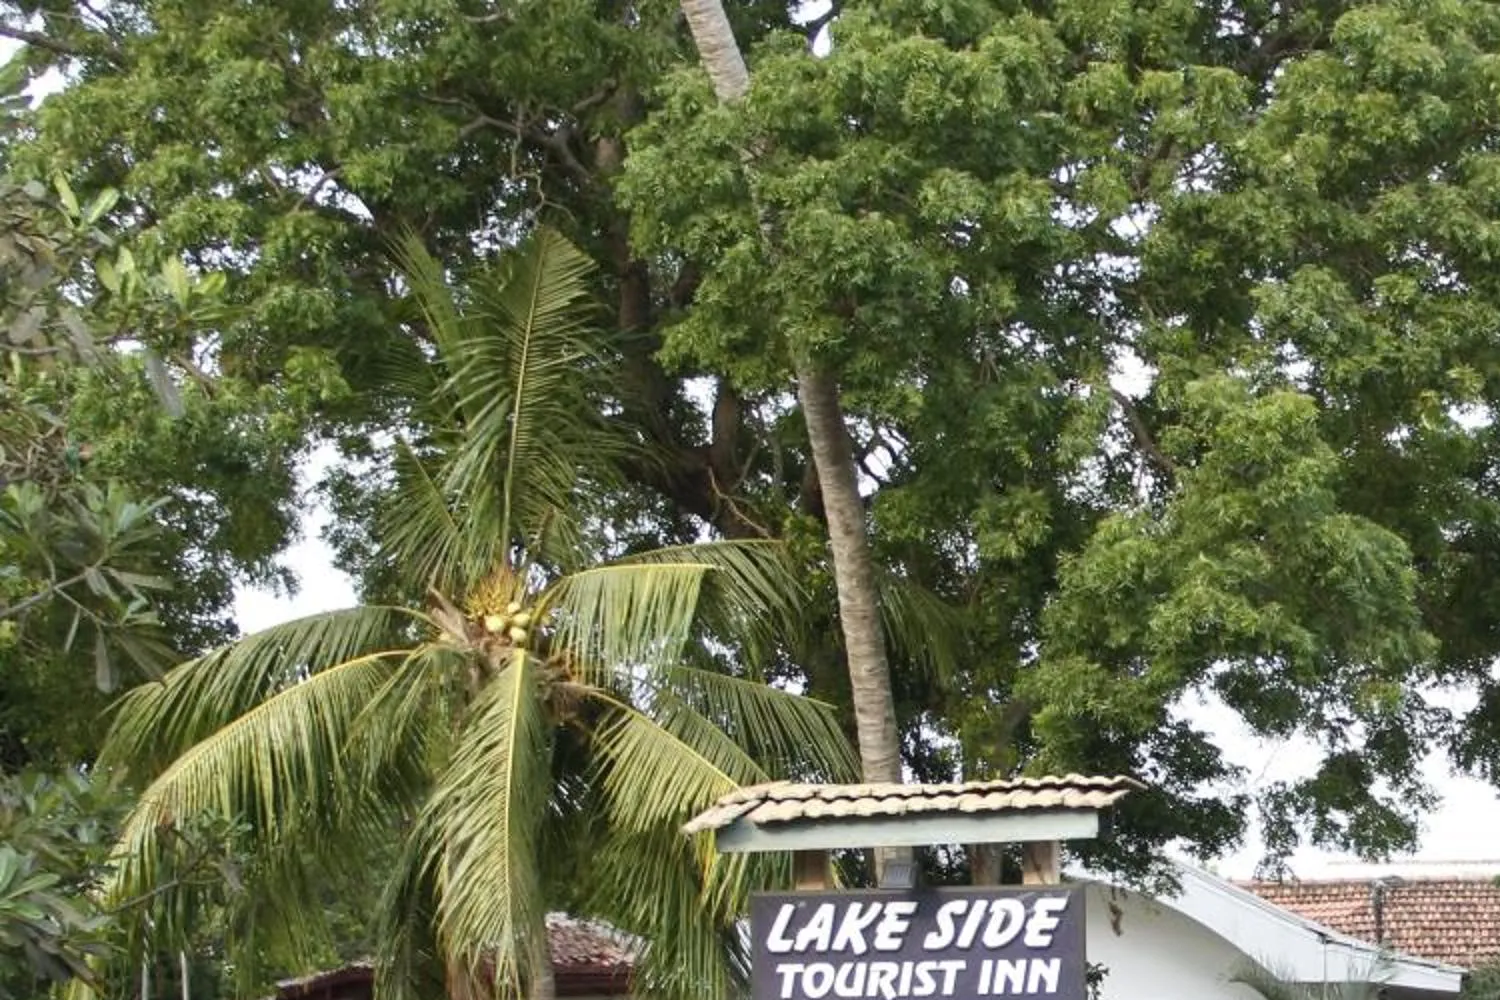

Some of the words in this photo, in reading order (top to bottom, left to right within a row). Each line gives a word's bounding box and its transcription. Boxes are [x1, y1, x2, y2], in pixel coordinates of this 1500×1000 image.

[766, 902, 919, 954] LAKE
[924, 898, 1068, 949] SIDE
[776, 960, 967, 1000] TOURIST
[978, 958, 1061, 995] INN
